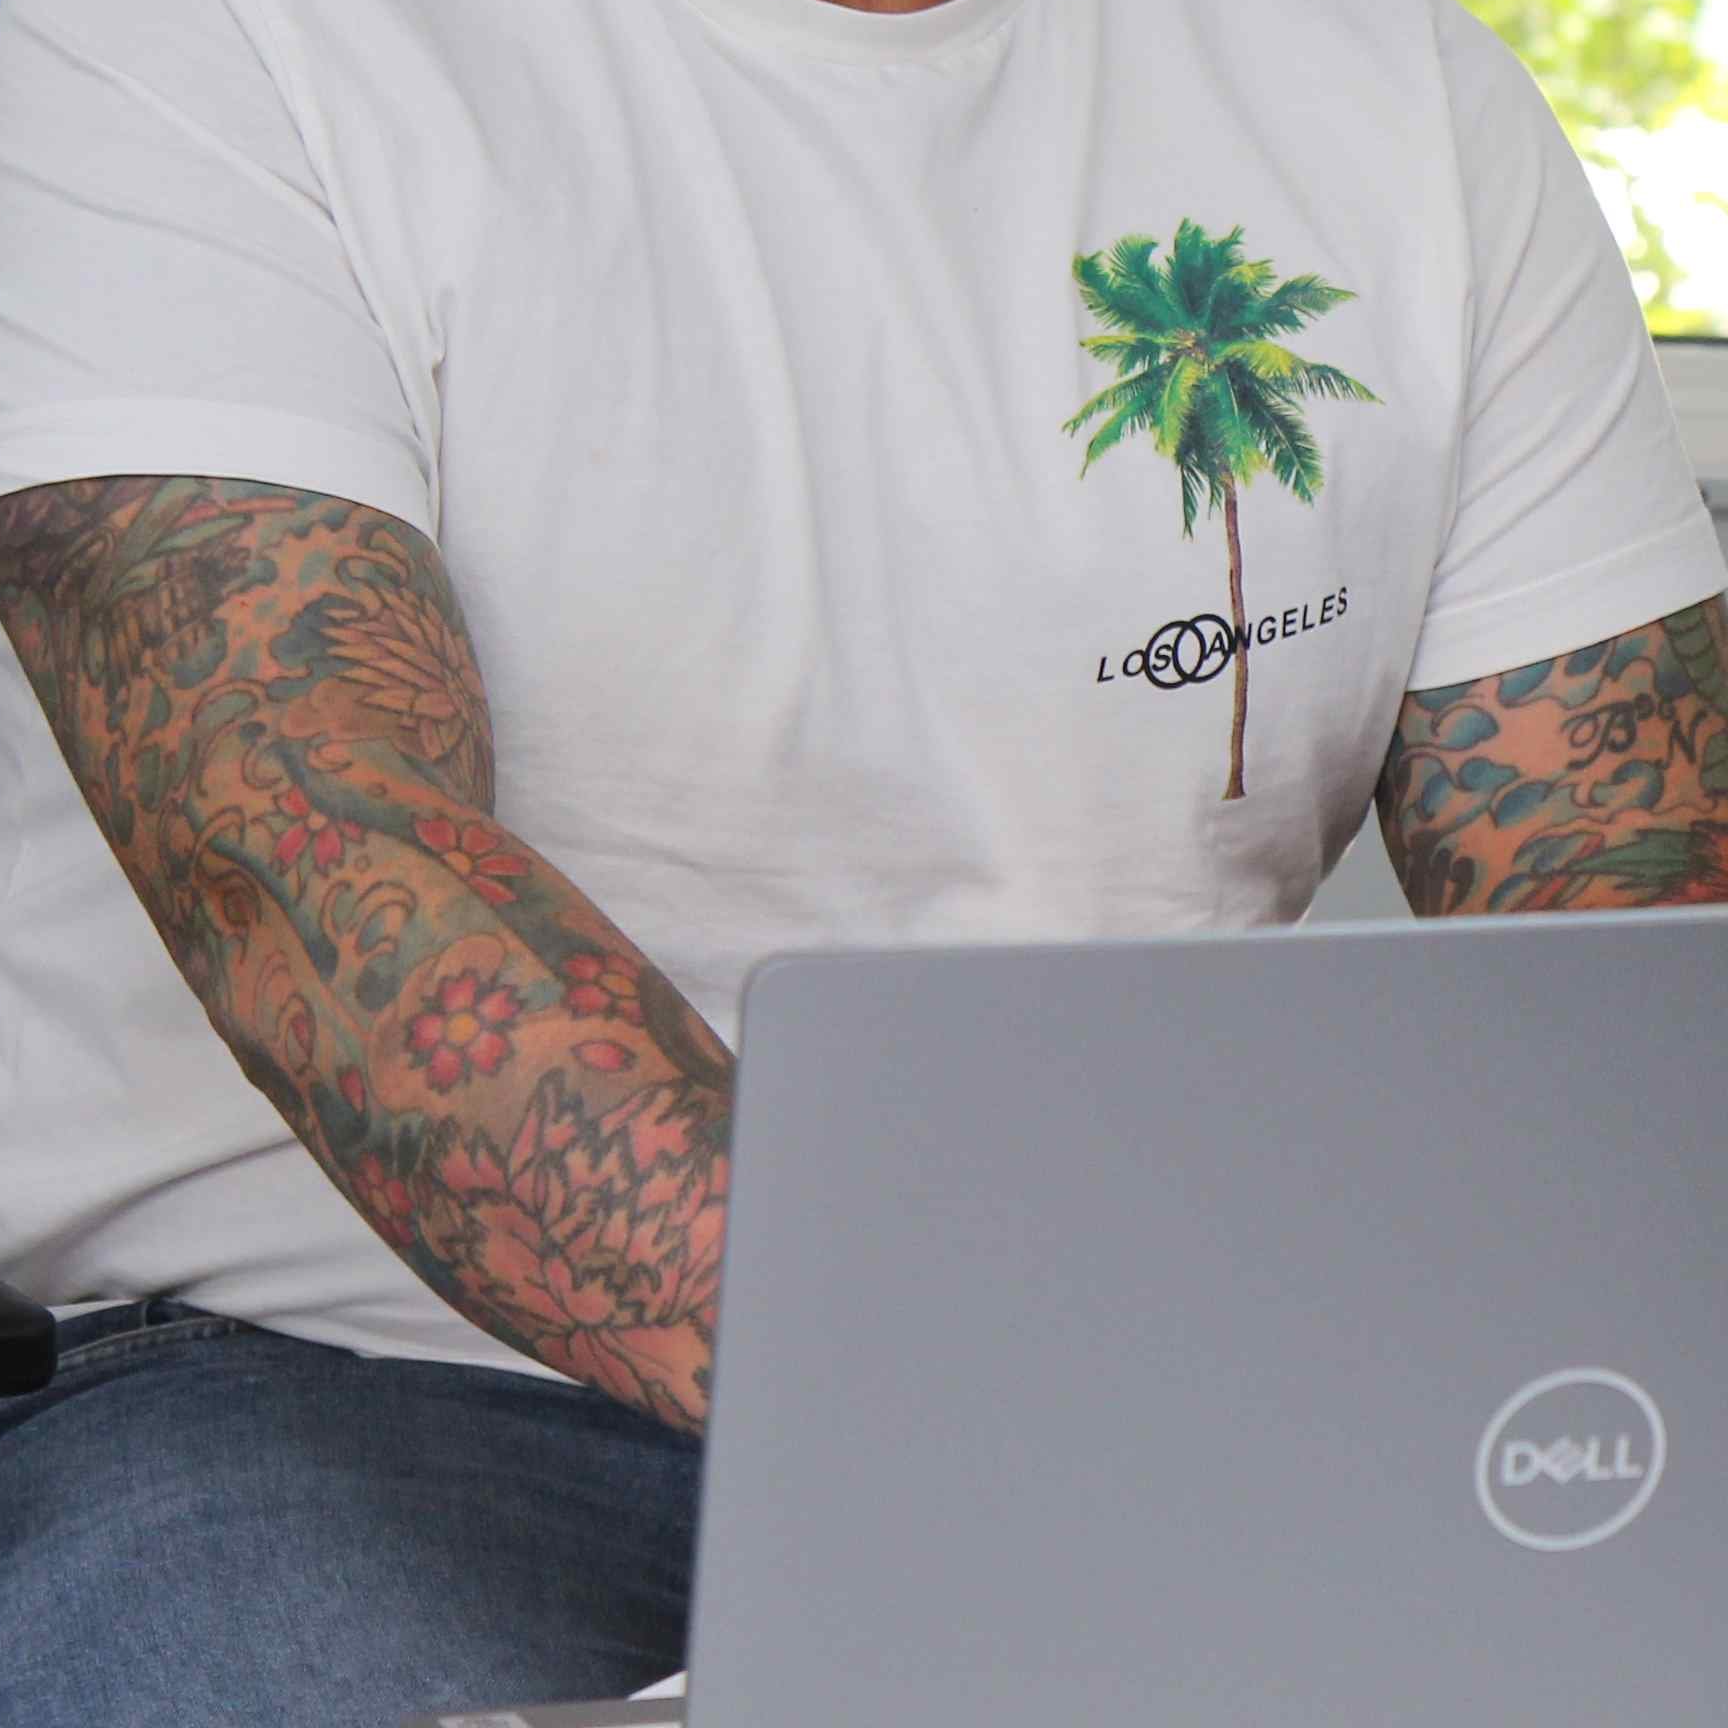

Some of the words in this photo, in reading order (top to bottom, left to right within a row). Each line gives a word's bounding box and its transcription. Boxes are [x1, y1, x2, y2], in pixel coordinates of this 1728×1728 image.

[1096, 642, 1173, 683] LOS
[1203, 585, 1348, 661] ANGELES
[1502, 1434, 1645, 1488] DELL
